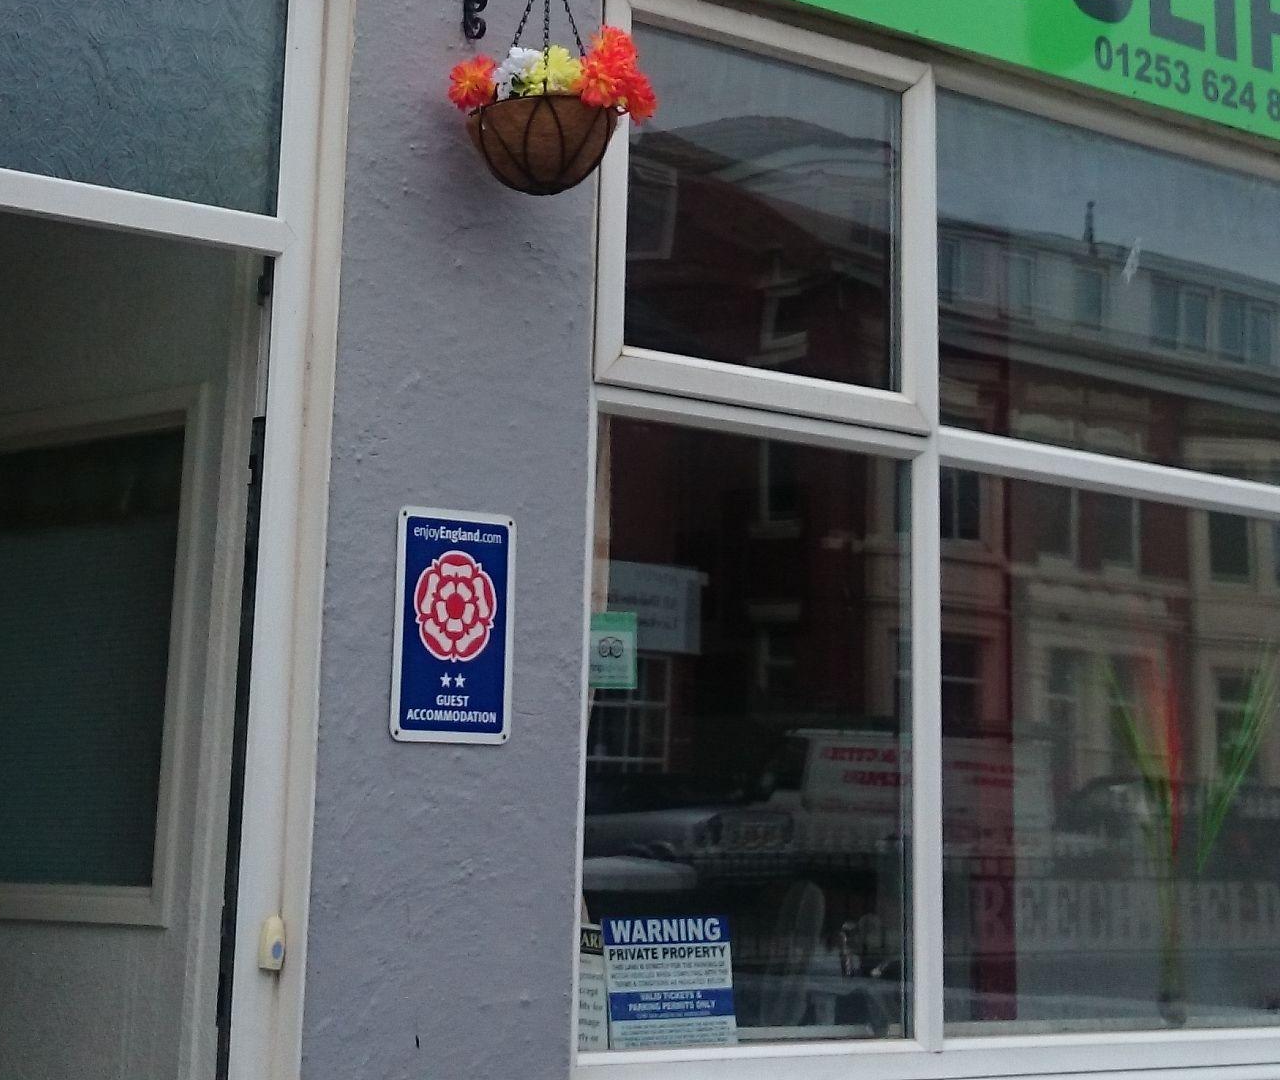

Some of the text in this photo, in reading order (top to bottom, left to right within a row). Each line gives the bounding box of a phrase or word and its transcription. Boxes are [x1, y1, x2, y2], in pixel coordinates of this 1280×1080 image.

[1094, 35, 1191, 98] 01253
[1202, 66, 1258, 114] 624
[413, 525, 502, 544] enjoyEngland.com
[436, 695, 469, 707] GUEST
[407, 708, 496, 723] ACCOMMODATION
[610, 917, 721, 943] WARNING
[609, 945, 726, 961] PRIVATE PROPERTY
